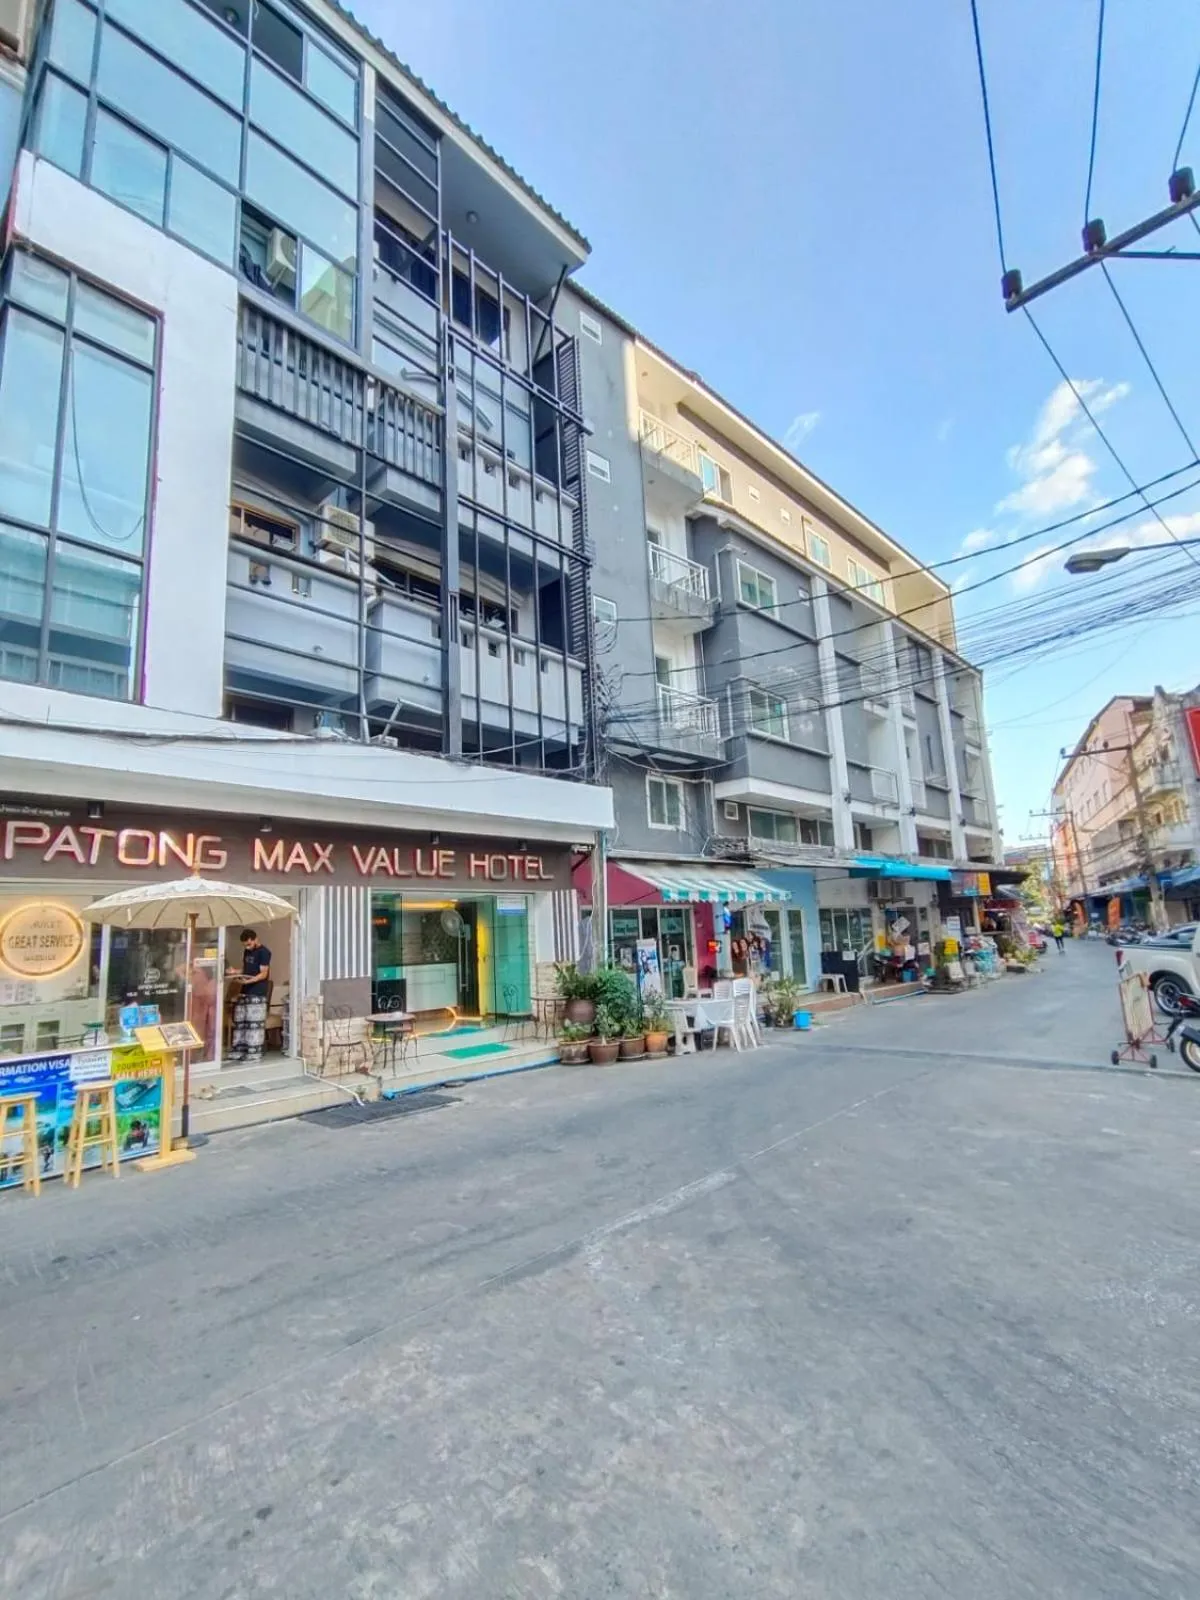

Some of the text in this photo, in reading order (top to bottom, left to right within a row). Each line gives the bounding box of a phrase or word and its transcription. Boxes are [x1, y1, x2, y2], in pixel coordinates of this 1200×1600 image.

[5, 820, 556, 881] PATONG MAX VALUE HOTEL
[8, 934, 74, 949] GREAT SERVICE
[48, 1058, 70, 1071] VISA
